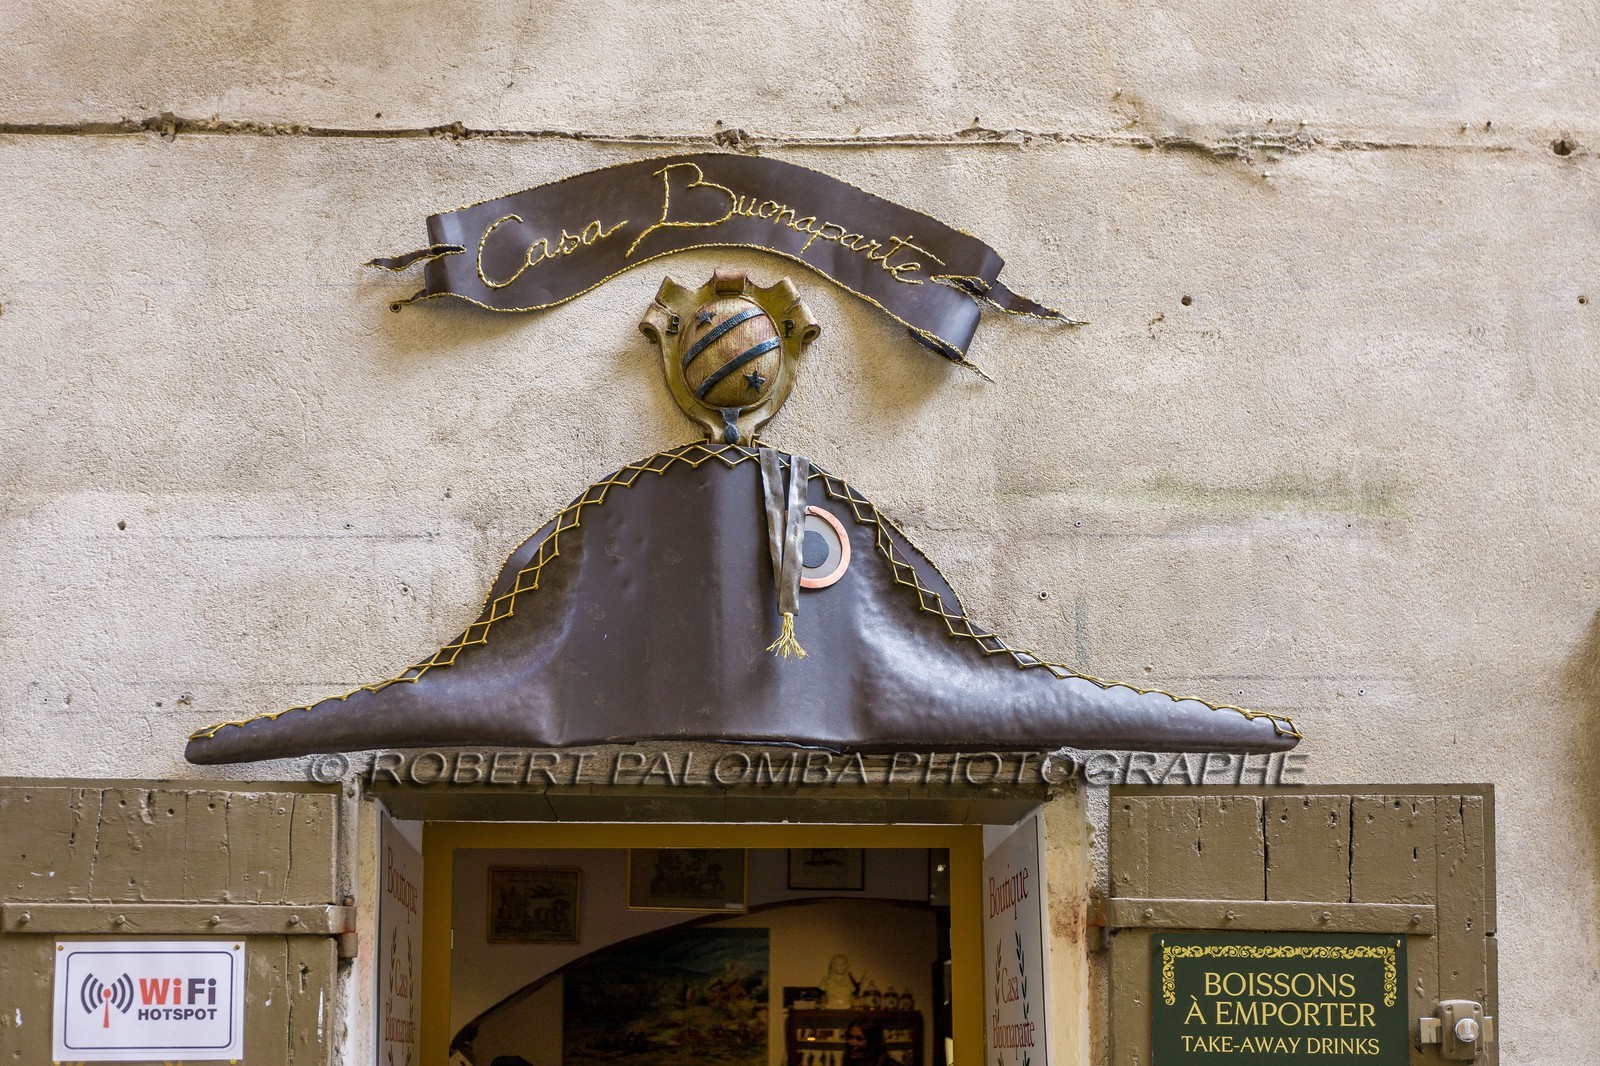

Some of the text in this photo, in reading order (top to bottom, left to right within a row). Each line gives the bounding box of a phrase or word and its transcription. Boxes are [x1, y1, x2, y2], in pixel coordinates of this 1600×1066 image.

[476, 162, 946, 290] Casa Buonaparte
[387, 845, 418, 924] Boutique
[989, 864, 1029, 920] Boutique
[139, 977, 217, 1006] WiFi
[394, 958, 408, 999] Casa
[1001, 967, 1019, 1004] Casa
[1203, 971, 1357, 998] BOISSONS
[137, 1008, 218, 1021] HOTSPOT
[1183, 994, 1377, 1028] À EMPORTER
[992, 1013, 1036, 1061] Buonaparte
[1180, 1035, 1380, 1055] TAKE-AWAY DRINKS
